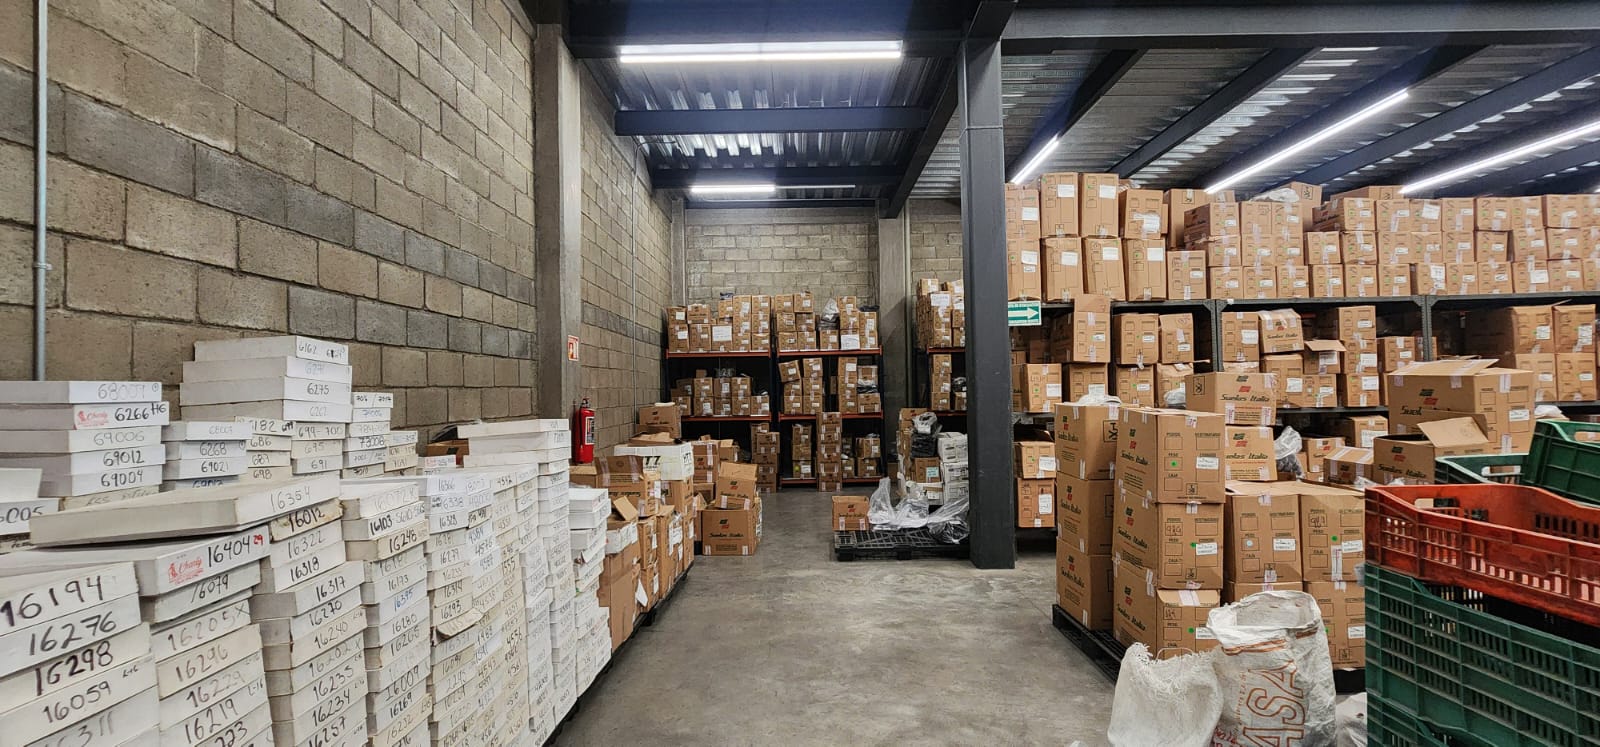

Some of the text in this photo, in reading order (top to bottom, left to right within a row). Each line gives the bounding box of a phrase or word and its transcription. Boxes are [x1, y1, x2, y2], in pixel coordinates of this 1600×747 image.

[115, 406, 149, 420] 6266
[103, 450, 145, 466] 69012
[101, 469, 144, 487] 69004
[289, 508, 325, 532] 16012
[208, 535, 250, 567] 16404
[290, 556, 320, 582] 16318
[1, 576, 103, 627] 16194
[316, 576, 345, 601] 16317
[29, 611, 116, 656] 16276
[35, 640, 114, 696] 16298
[43, 680, 111, 723] 16059
[312, 687, 350, 727] 16234
[185, 698, 239, 744] 16219
